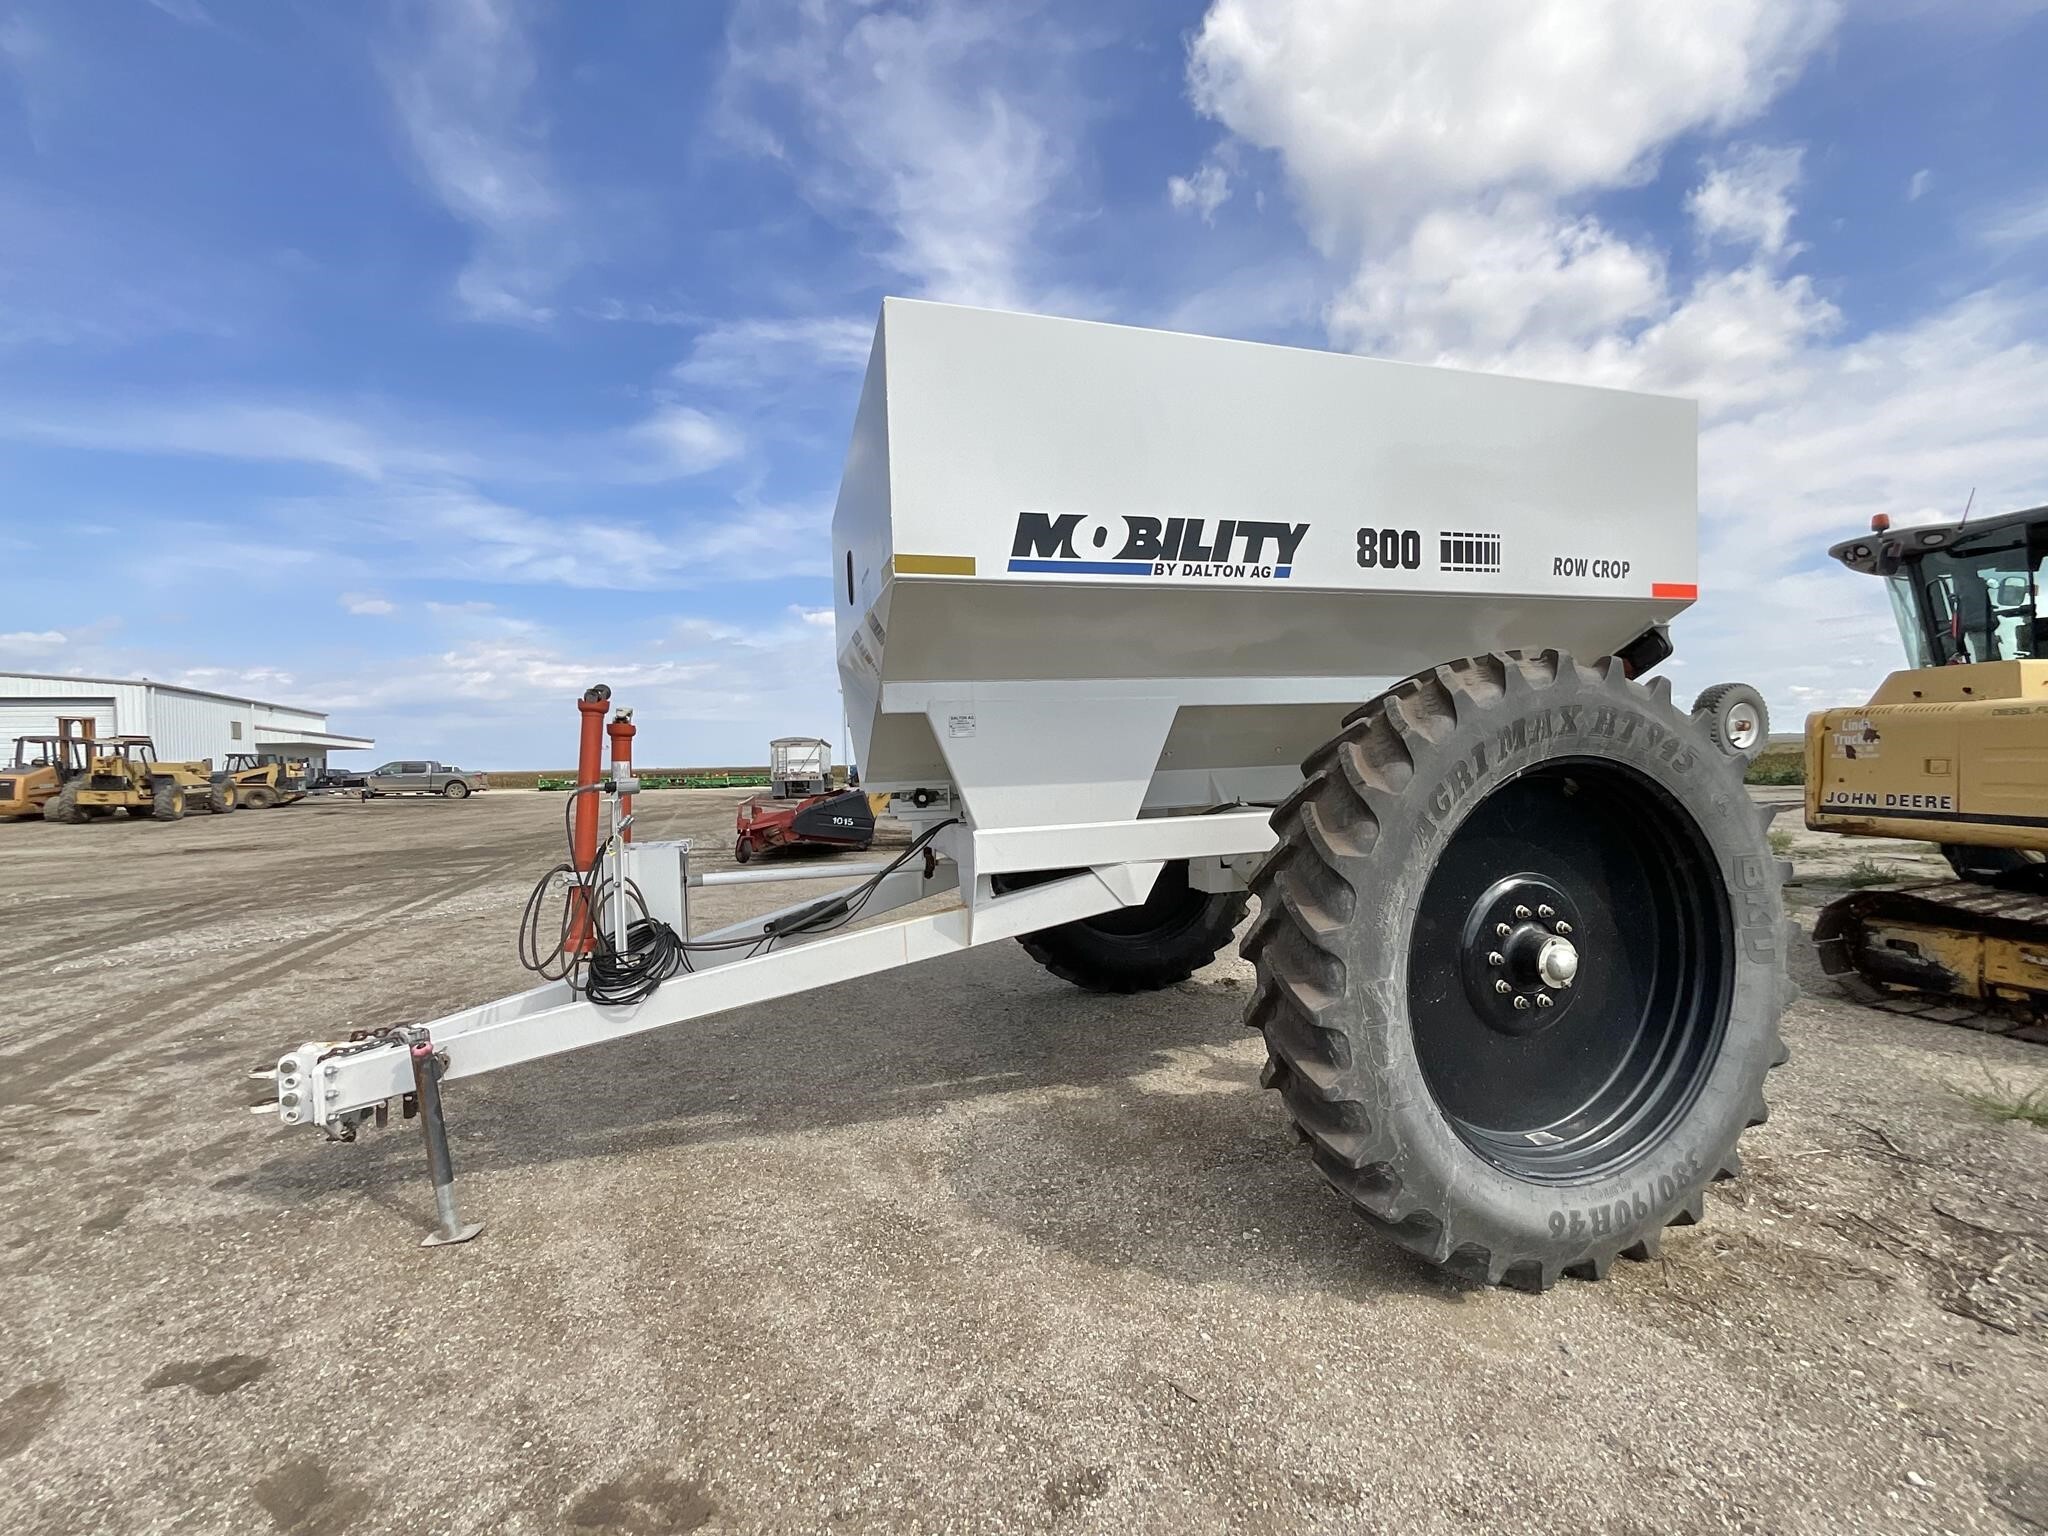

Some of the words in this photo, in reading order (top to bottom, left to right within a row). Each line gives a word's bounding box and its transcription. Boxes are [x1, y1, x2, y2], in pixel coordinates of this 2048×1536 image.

[1012, 512, 1311, 564] MOBILITY
[1356, 528, 1421, 570] 800
[1153, 563, 1177, 576] BY
[1182, 564, 1246, 578] DALTON
[1250, 566, 1272, 579] AG
[1553, 557, 1588, 577] ROW
[1592, 559, 1630, 579] CROP
[1412, 741, 1489, 855] AGRI
[1497, 704, 1583, 763] MAX
[1825, 791, 1877, 805] JOHN
[1886, 793, 1951, 809] DEERE
[832, 816, 854, 826] 1015
